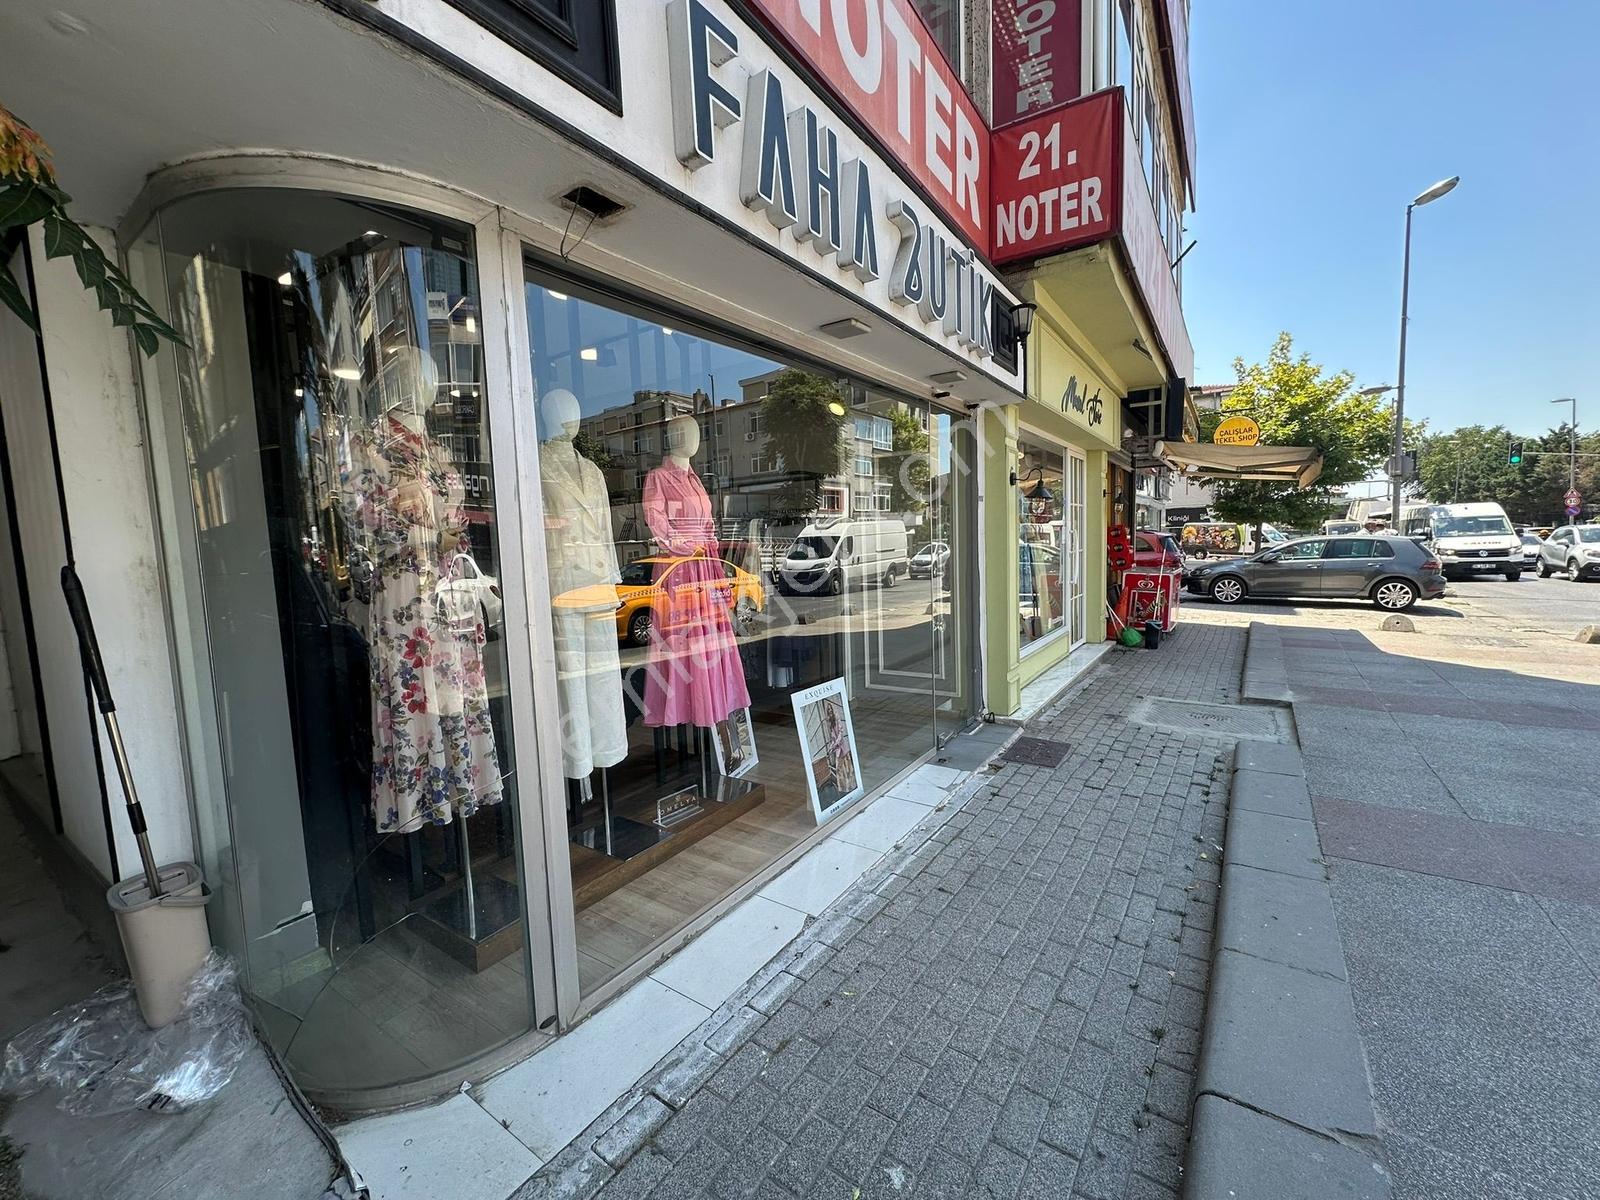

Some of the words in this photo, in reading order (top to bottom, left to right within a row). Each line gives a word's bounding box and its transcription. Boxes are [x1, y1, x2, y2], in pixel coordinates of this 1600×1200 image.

[1016, 0, 1056, 113] OTER
[670, 0, 880, 281] FAHA
[799, 0, 982, 231] OTER
[1018, 122, 1077, 180] 21.
[997, 177, 1102, 248] NOTER
[1215, 436, 1237, 445] TEKEL
[1238, 433, 1257, 442] SHOP
